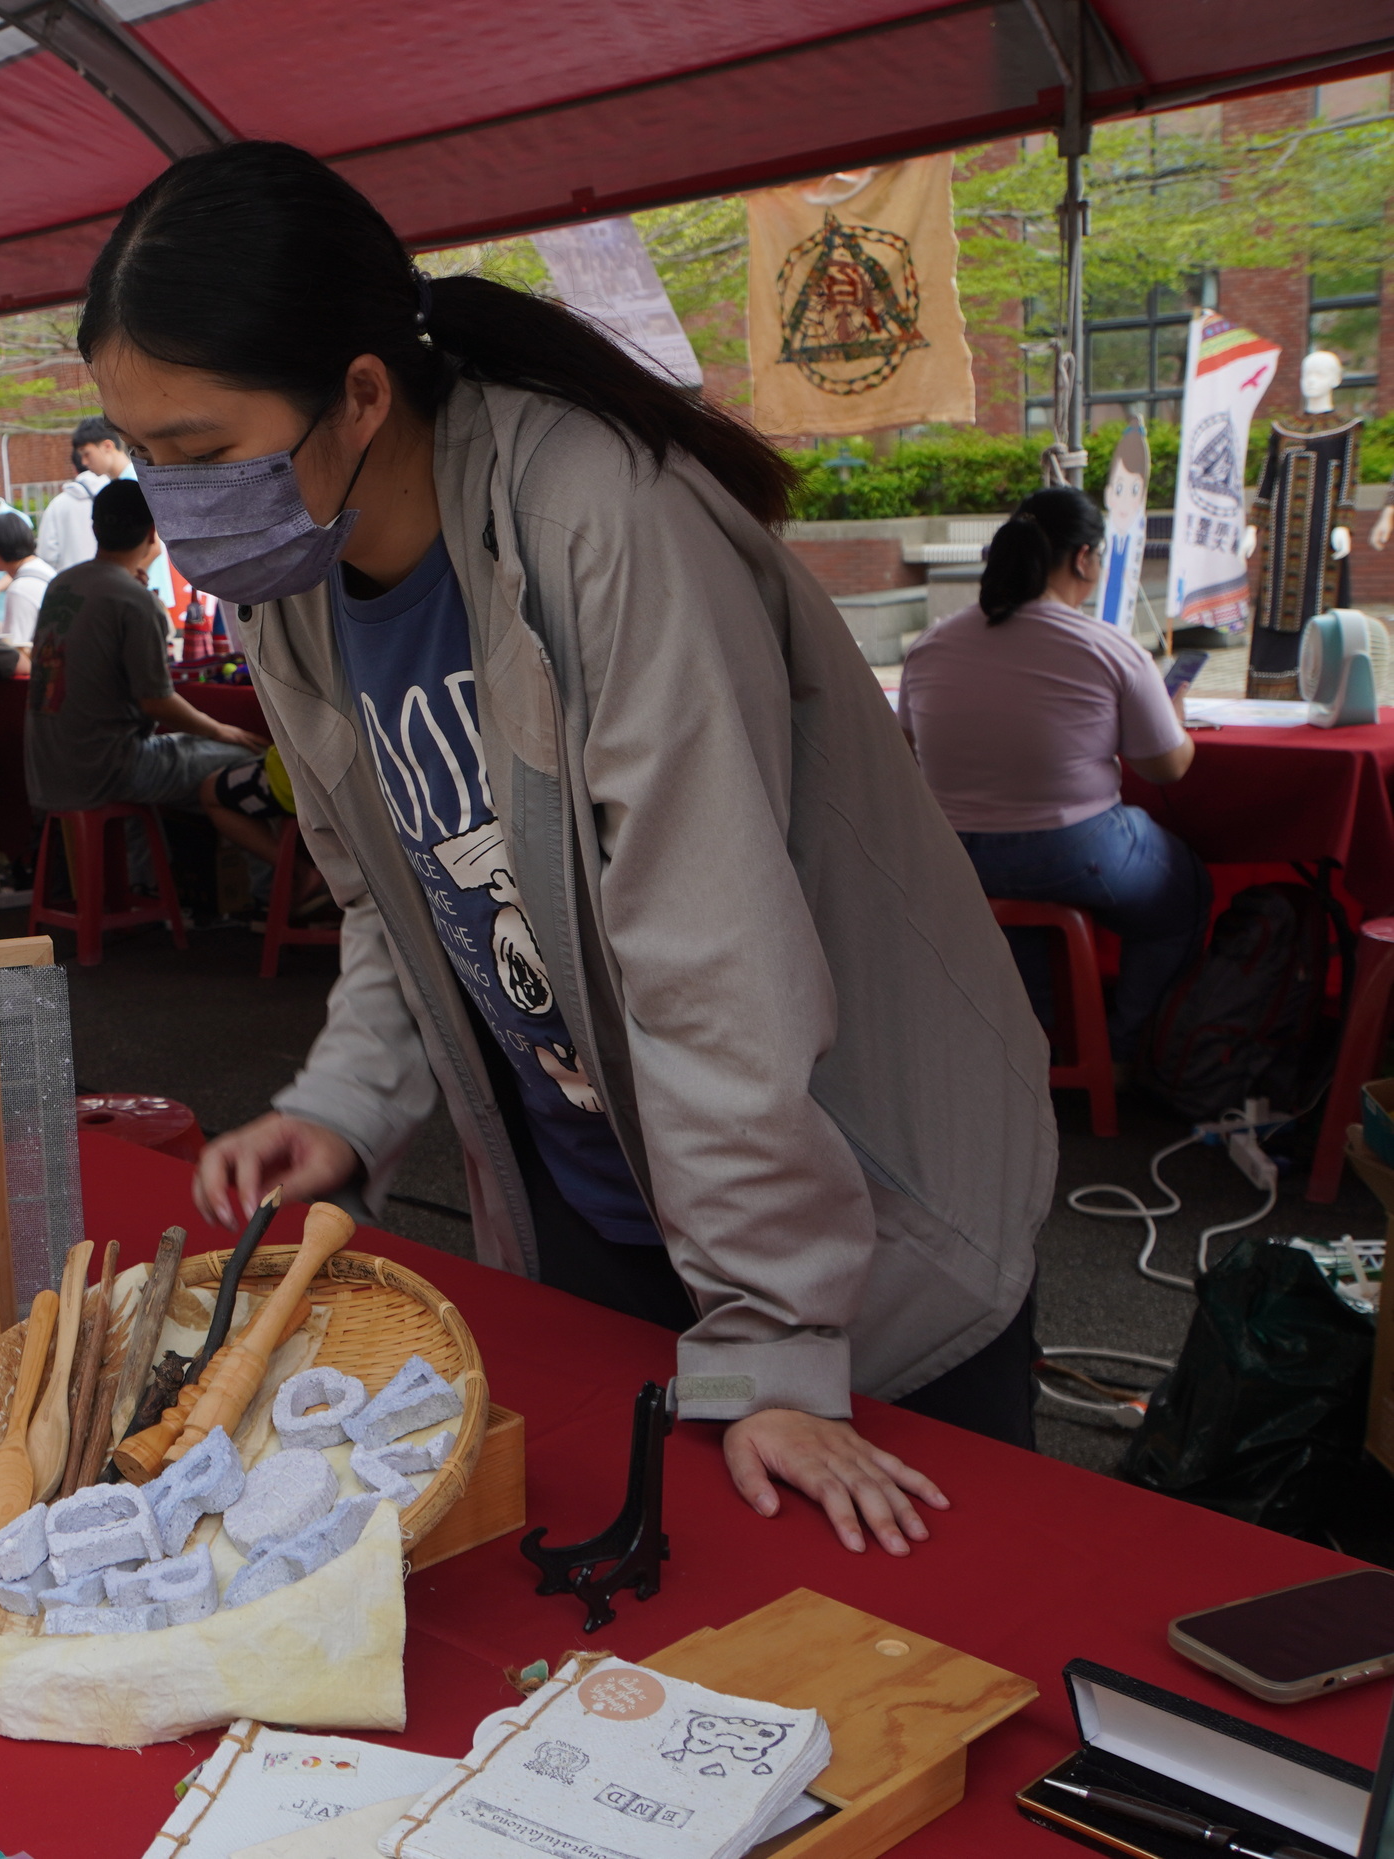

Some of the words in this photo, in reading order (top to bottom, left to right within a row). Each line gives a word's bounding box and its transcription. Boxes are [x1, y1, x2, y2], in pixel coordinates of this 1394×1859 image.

[421, 882, 457, 916] AKE
[439, 918, 478, 953] THE
[607, 1791, 681, 1823] END
